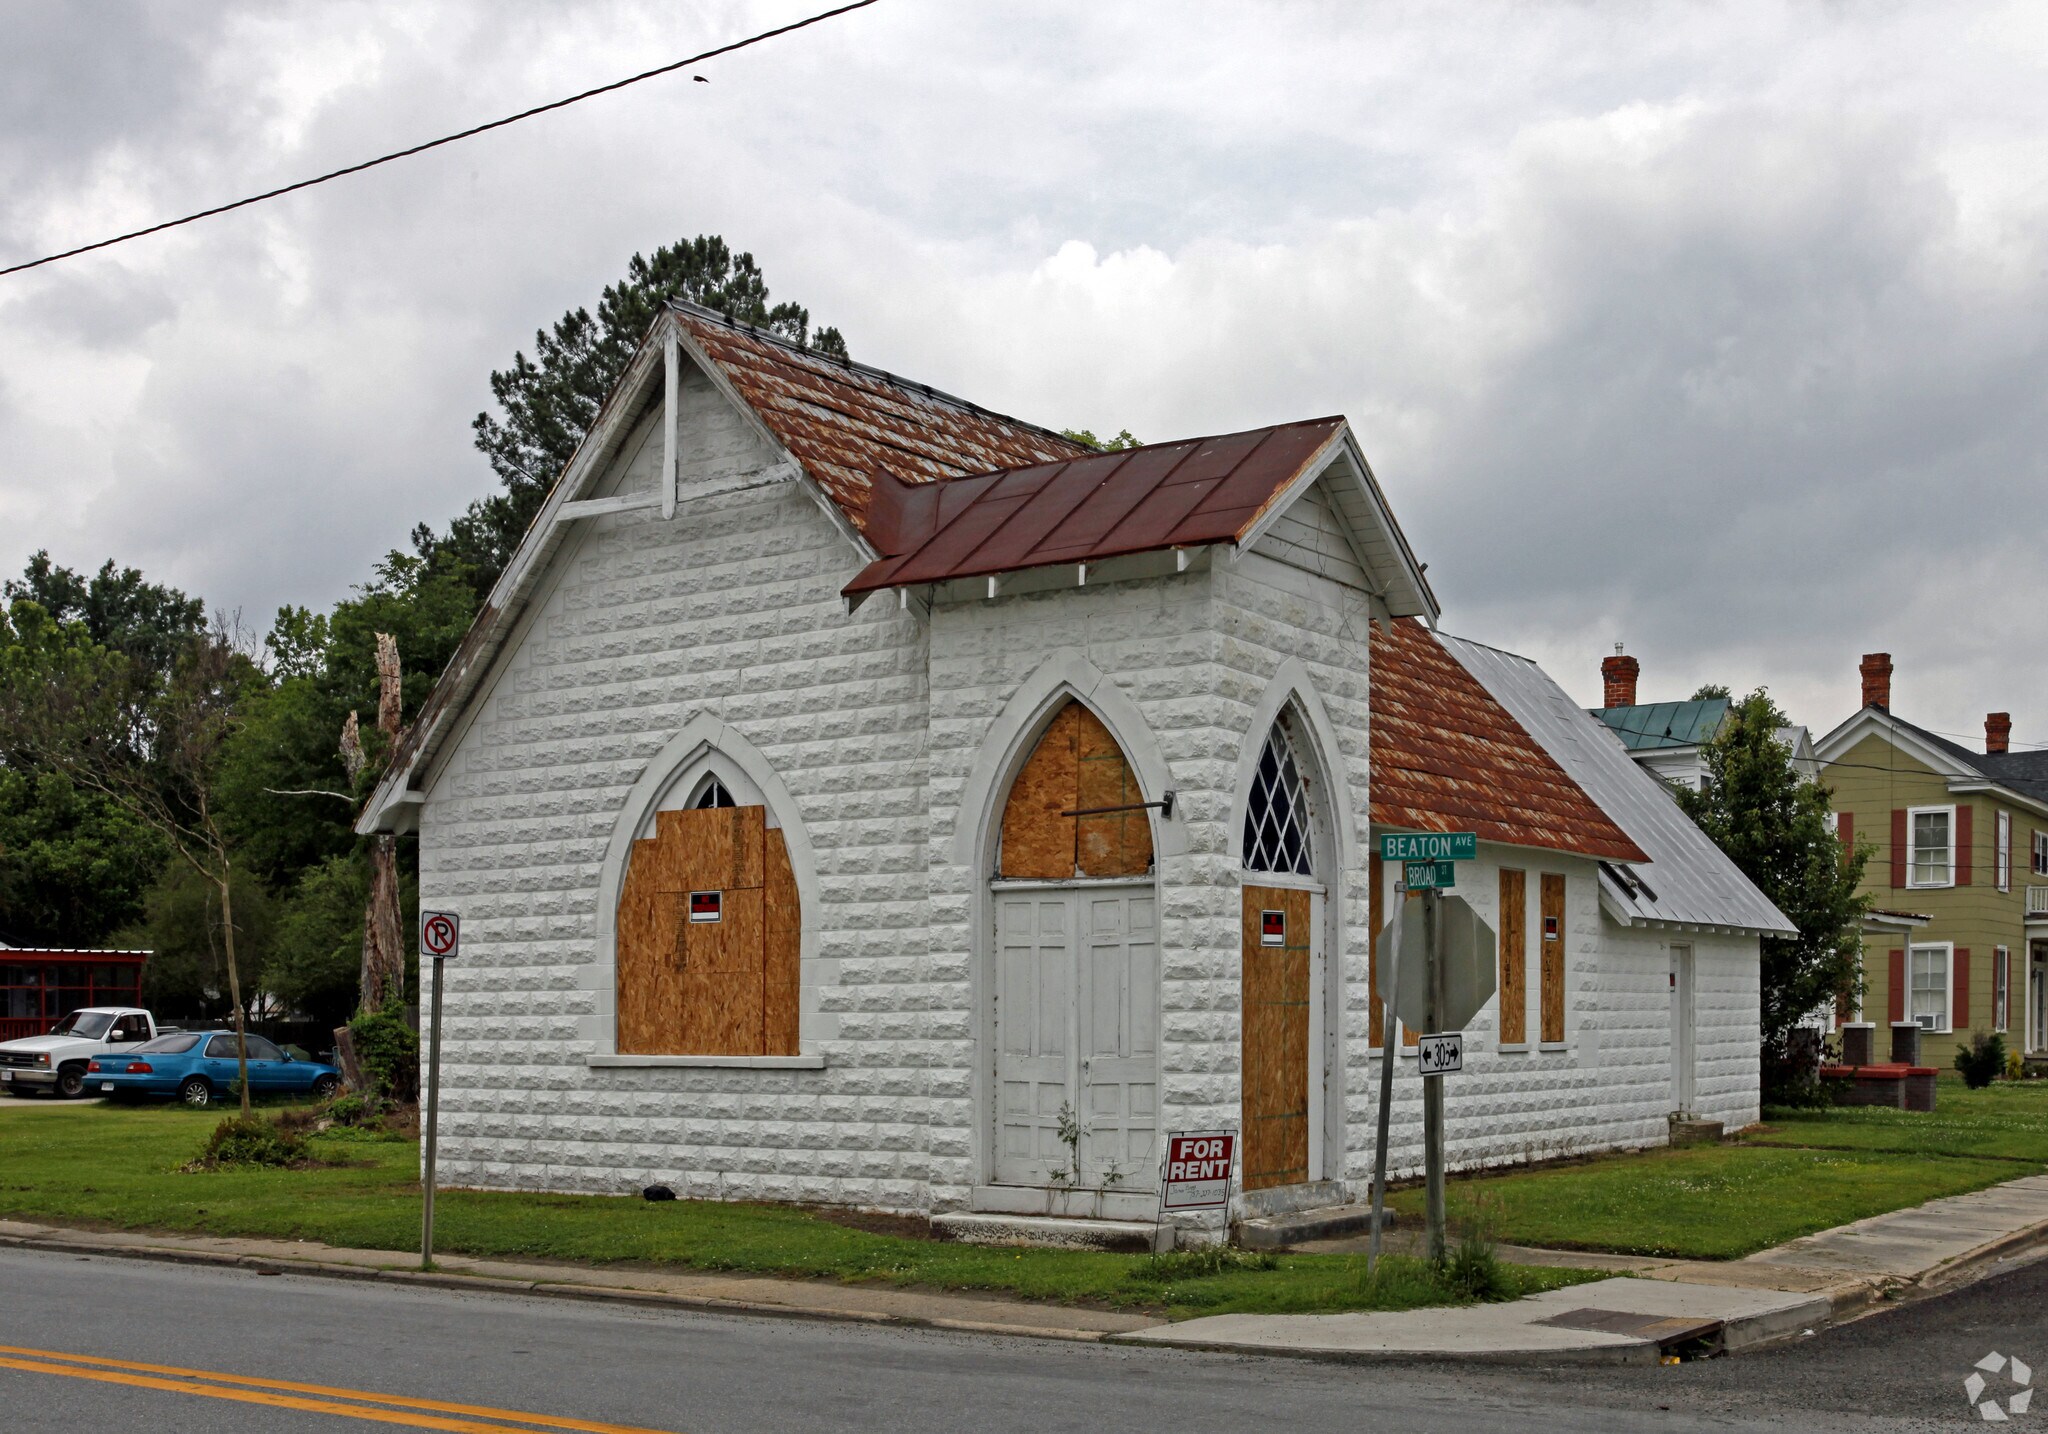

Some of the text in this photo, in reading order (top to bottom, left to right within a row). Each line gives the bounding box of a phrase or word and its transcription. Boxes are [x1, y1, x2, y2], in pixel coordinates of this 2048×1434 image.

[1387, 835, 1473, 857] BEATON AVE
[1408, 864, 1447, 887] BROAD ST
[434, 922, 449, 946] P
[1179, 1139, 1224, 1159] FOR
[1169, 1159, 1229, 1180] RENT
